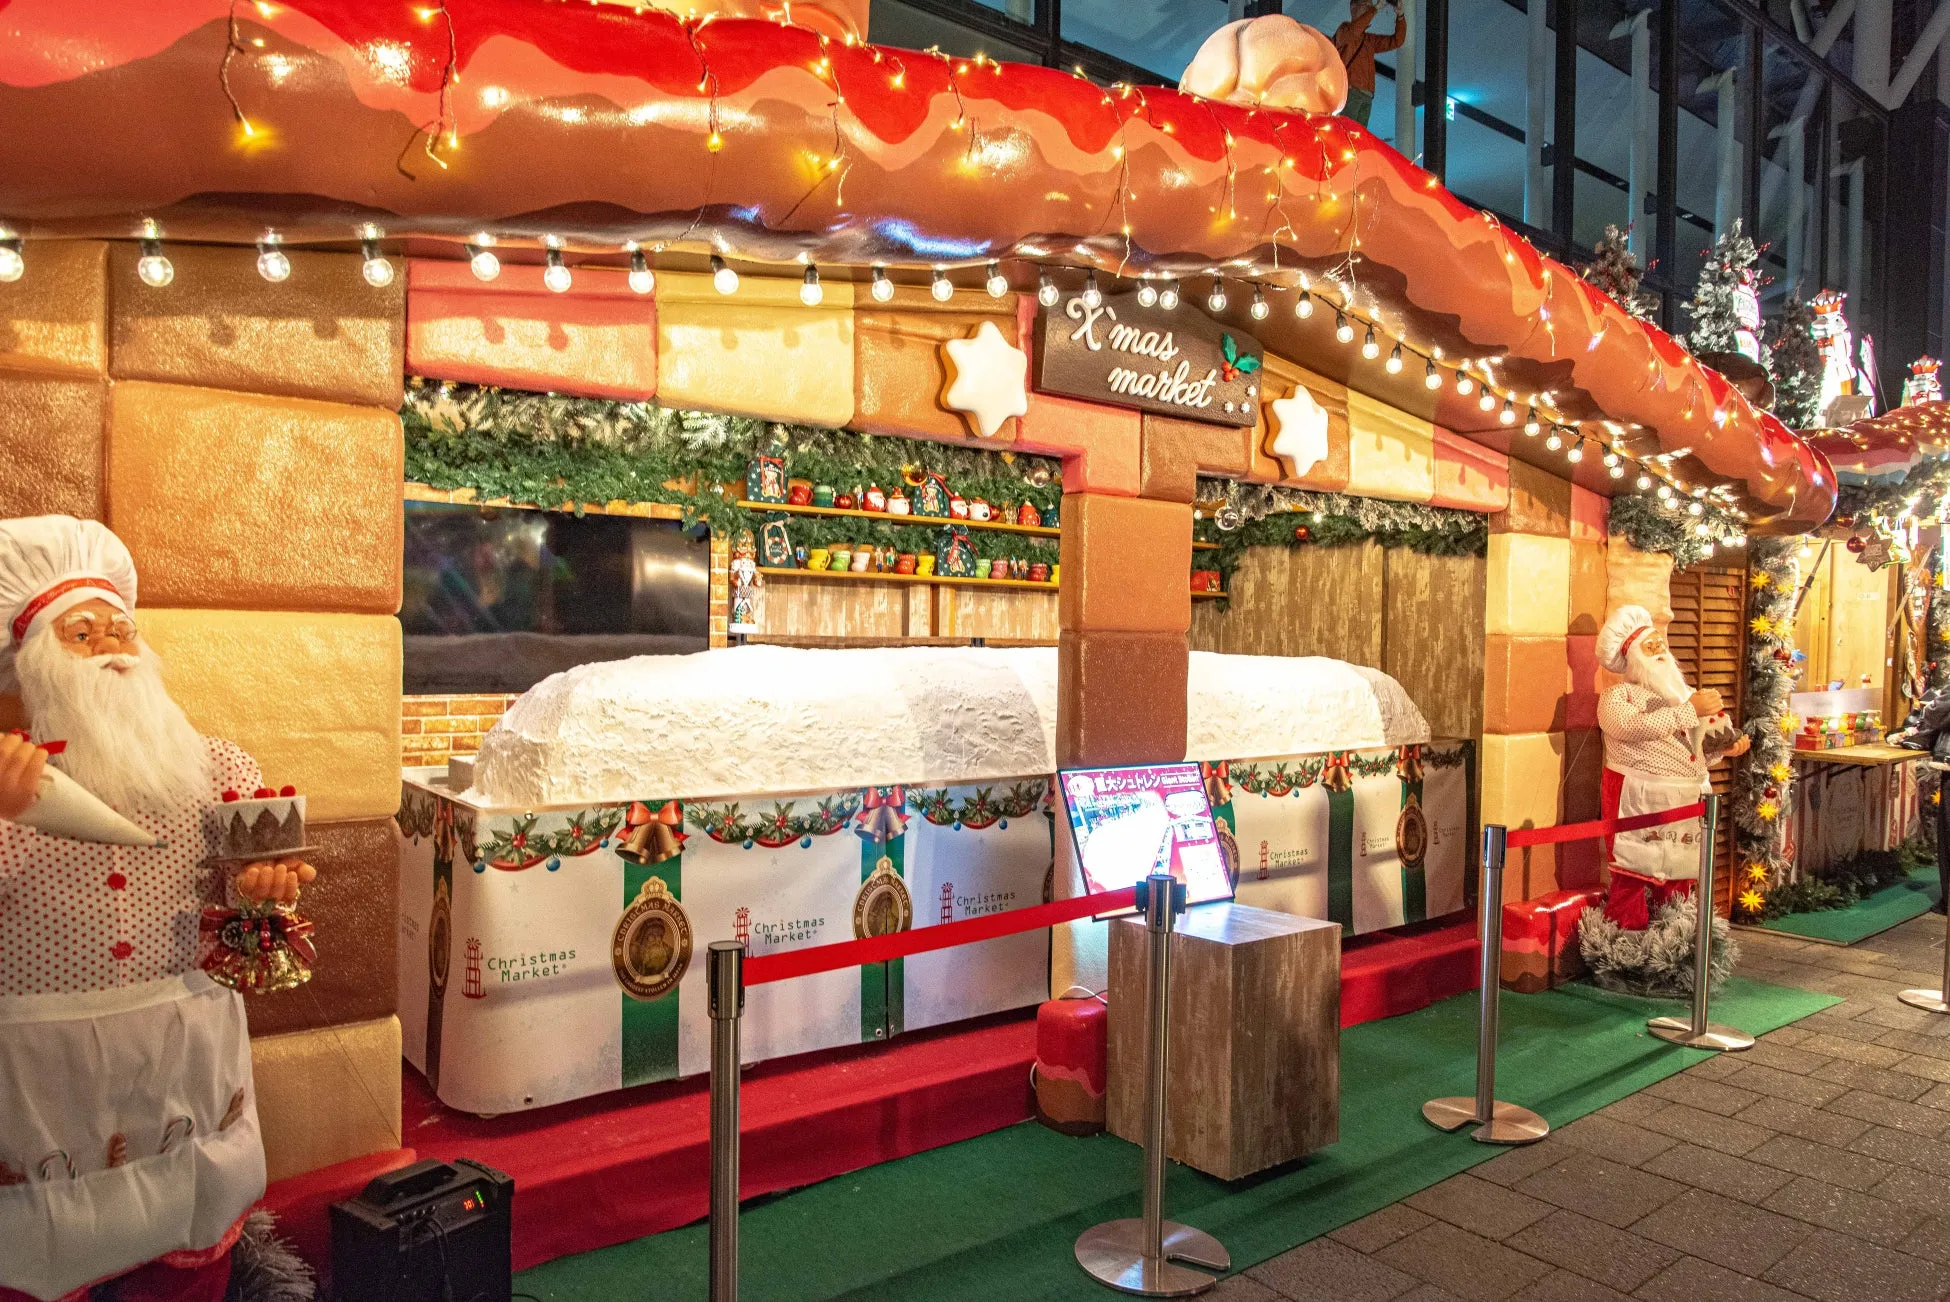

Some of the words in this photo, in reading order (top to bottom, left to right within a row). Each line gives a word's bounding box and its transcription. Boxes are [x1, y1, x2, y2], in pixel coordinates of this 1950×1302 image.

[1108, 360, 1217, 408] market
[1270, 848, 1308, 860] Christmas
[1276, 858, 1300, 868] Market
[956, 891, 1016, 906] Christmas
[964, 903, 1004, 915] Market
[754, 916, 825, 934] Christmas
[764, 930, 812, 945] Market
[487, 948, 577, 971] Christmas
[500, 964, 560, 983] Market
